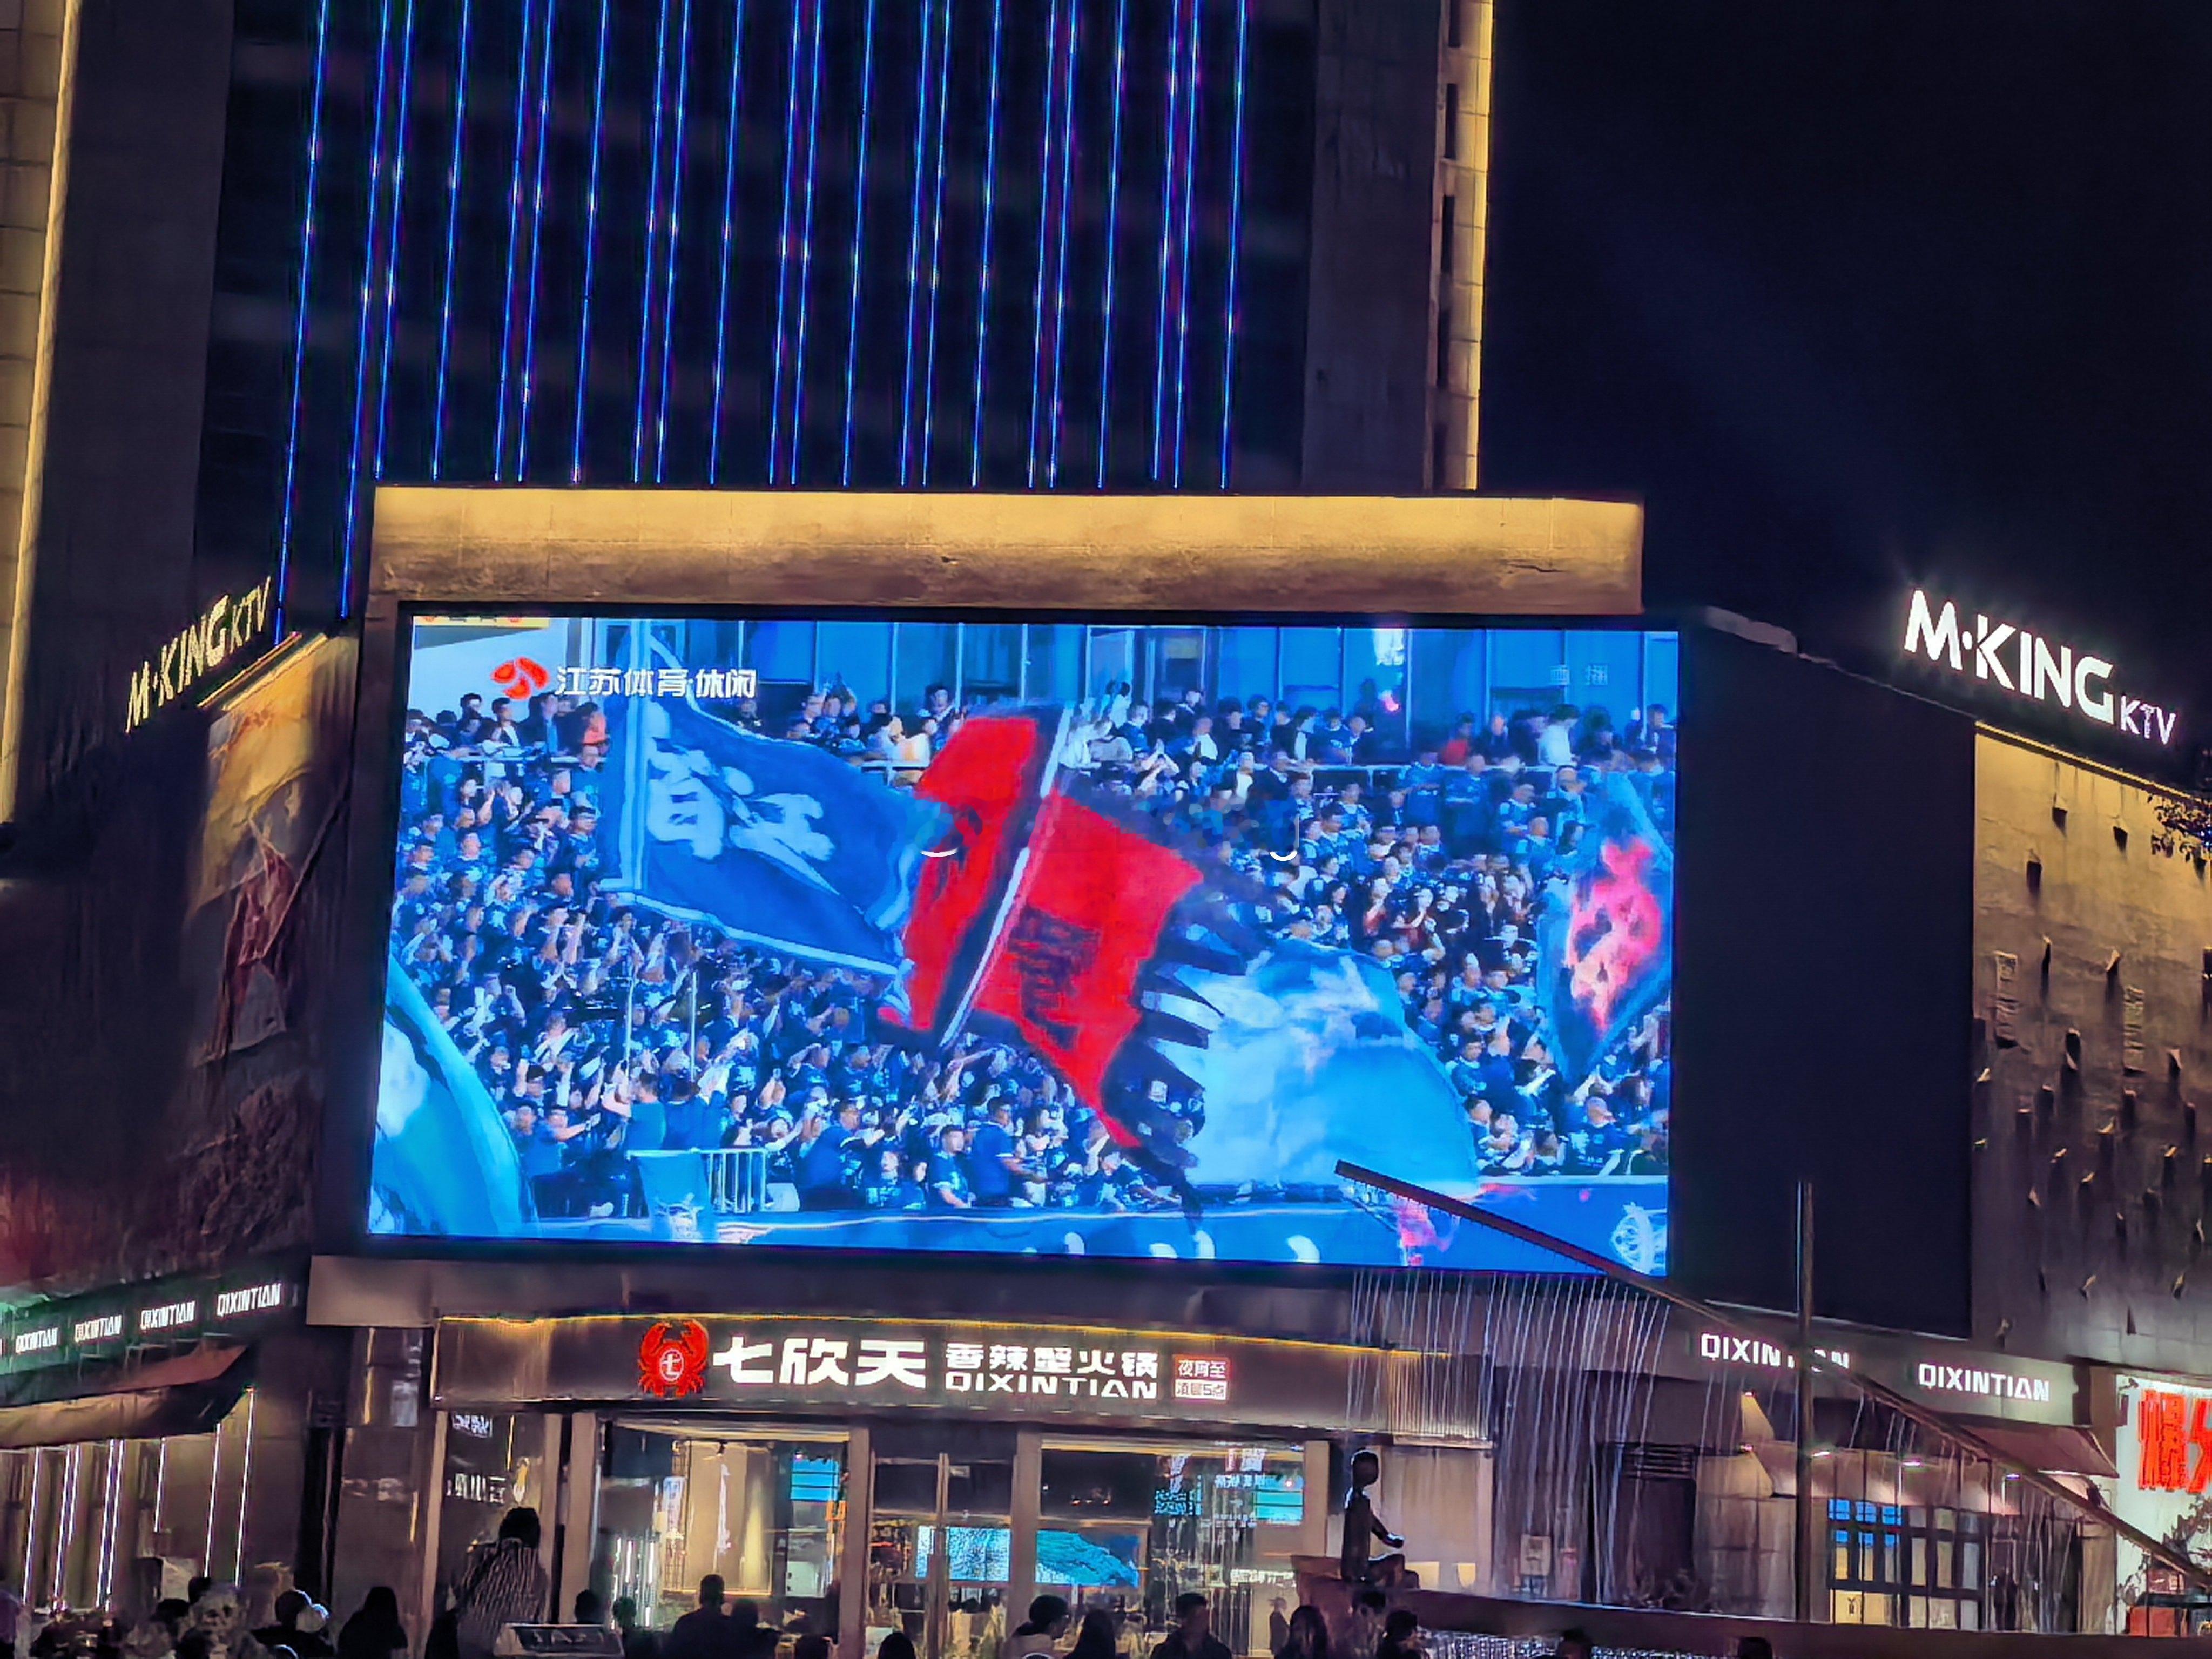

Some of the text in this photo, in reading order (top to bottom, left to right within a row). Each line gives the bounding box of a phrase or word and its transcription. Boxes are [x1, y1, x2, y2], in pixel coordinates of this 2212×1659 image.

[228, 576, 271, 655] KTV
[2120, 695, 2176, 745] KTV
[140, 1300, 195, 1331] QIXINTIAN
[217, 1283, 281, 1317] QIXINTIAN
[713, 1337, 926, 1389] 七欣天
[945, 1343, 1158, 1378] 香辣蟹火锅
[946, 1372, 1157, 1400] QIXINTIAN
[1918, 1363, 2050, 1402] QIXINTIAN
